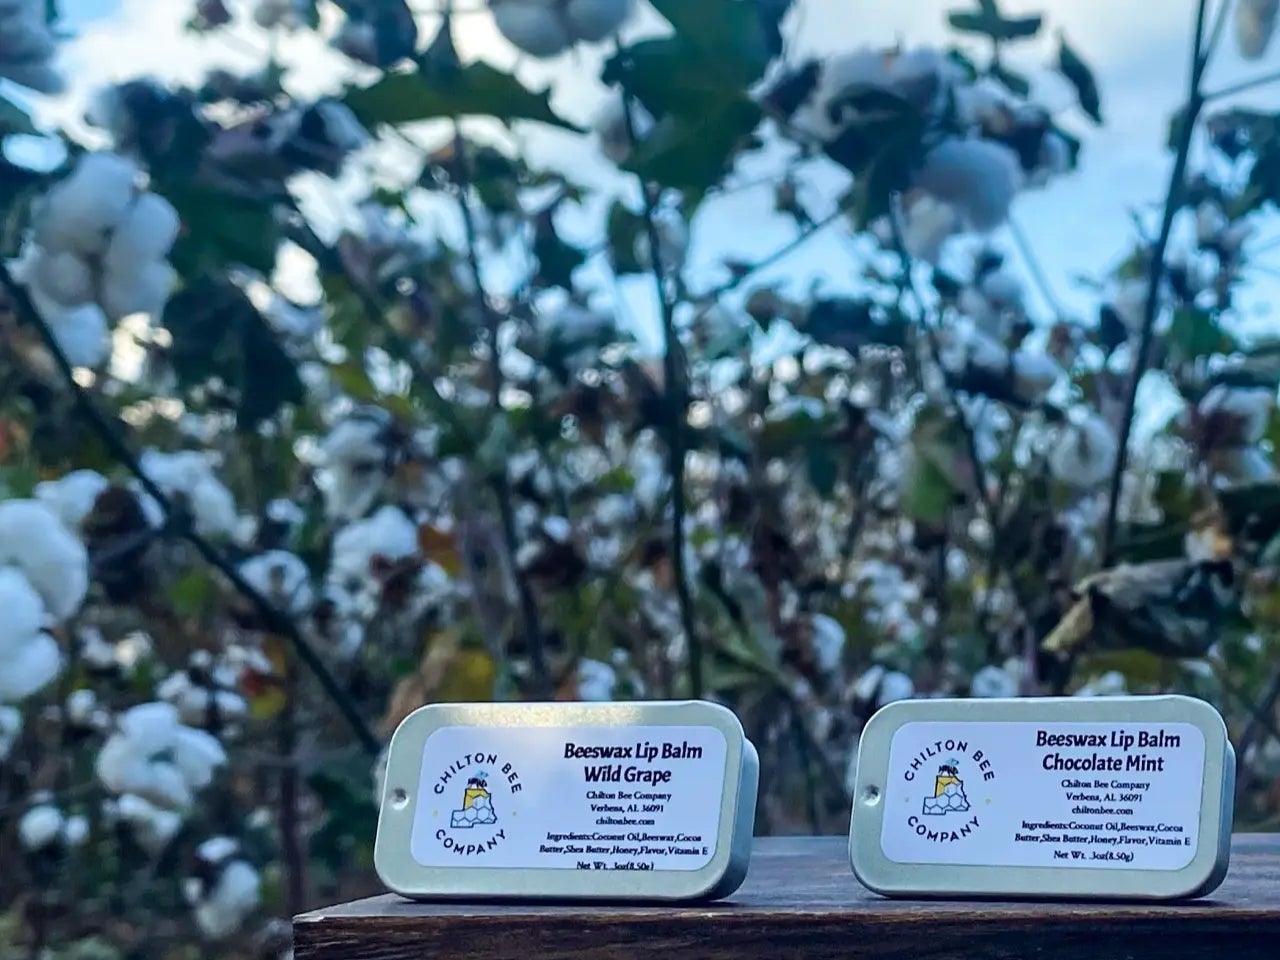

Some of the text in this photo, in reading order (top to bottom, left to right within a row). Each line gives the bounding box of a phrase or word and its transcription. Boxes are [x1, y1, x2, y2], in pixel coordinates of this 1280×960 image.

[1036, 731, 1180, 750] Beeswax Lip Balm
[564, 742, 702, 760] Beeswax Lip Balm
[904, 740, 995, 782] CHILTON BEE
[1043, 754, 1164, 771] Chocolate Mint
[434, 752, 522, 795] CHILTON BEE
[584, 767, 671, 785] Wild Grape
[1061, 780, 1150, 791] Chilton Bee Company
[586, 792, 672, 802] Chilton Bee Company
[908, 816, 980, 843] COMPANY
[435, 829, 506, 856] COMPANY
[1185, 837, 1190, 845] E
[1054, 851, 1069, 860] Net
